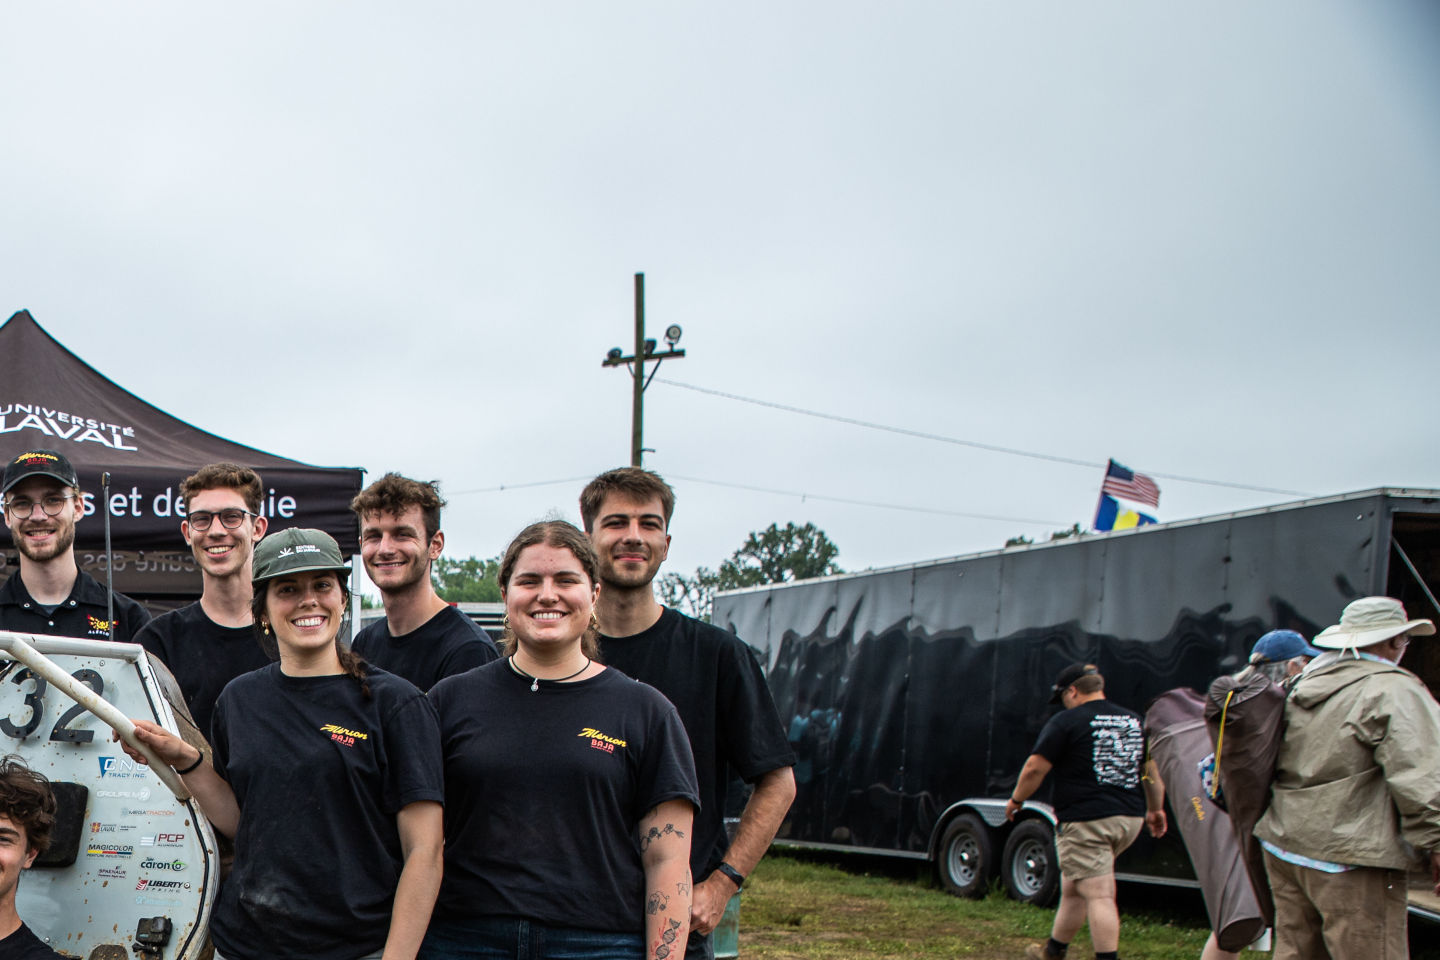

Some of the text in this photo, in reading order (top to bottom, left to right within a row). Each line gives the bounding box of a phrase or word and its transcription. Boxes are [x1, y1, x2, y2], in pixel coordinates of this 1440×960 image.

[110, 486, 142, 517] et
[331, 733, 355, 745] BAJA
[591, 738, 615, 752] BAJA
[158, 834, 185, 843] PCP
[88, 844, 134, 852] MAGICOLOR
[140, 861, 171, 870] caron
[148, 880, 184, 889] LIBERTY
